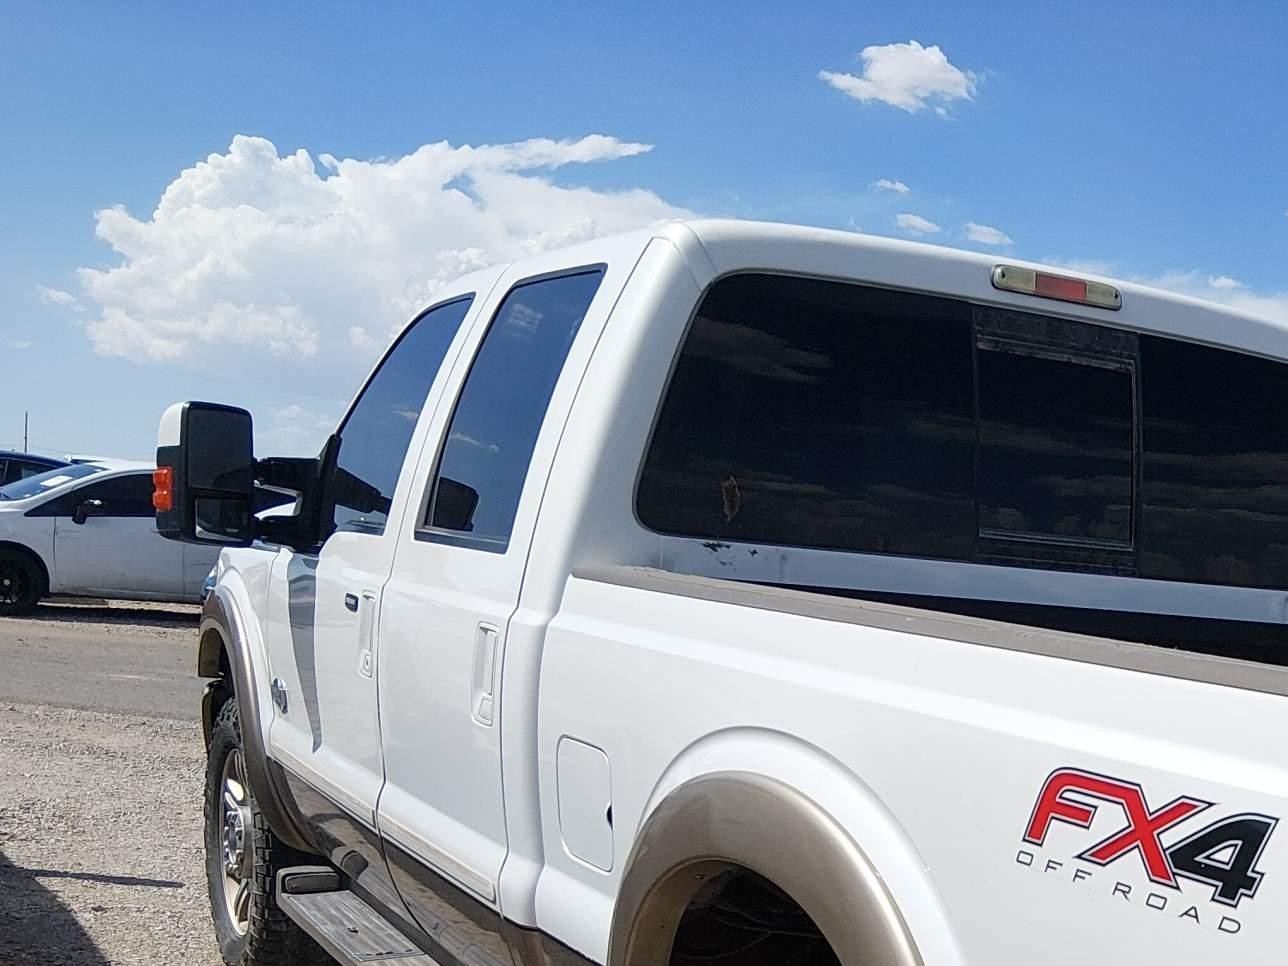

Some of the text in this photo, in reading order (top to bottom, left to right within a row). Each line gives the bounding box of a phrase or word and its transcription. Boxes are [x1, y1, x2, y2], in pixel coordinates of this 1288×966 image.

[1015, 850, 1242, 934] OFF ROAD
[1022, 766, 1280, 909] FX4
